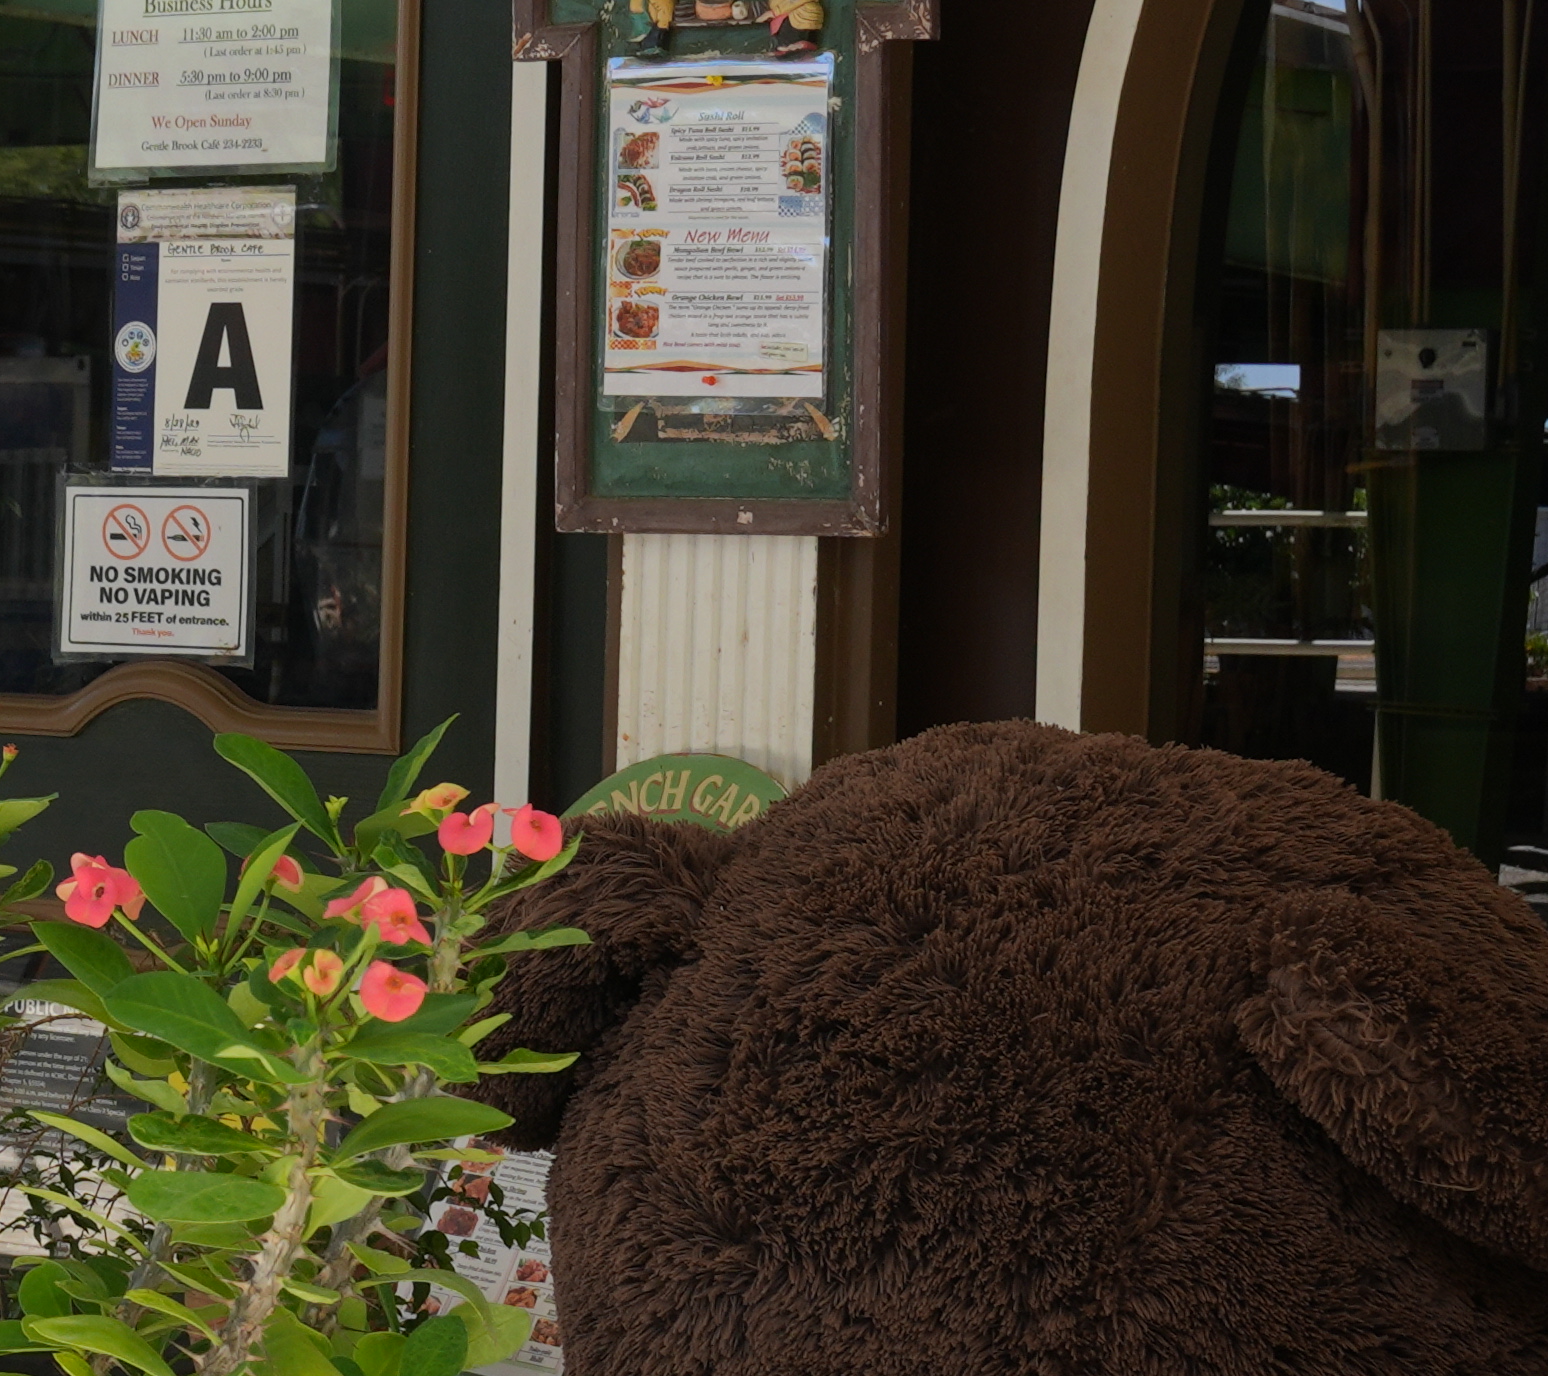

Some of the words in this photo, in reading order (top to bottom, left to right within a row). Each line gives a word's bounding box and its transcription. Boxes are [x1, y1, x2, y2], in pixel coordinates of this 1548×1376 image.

[112, 29, 159, 45] LUNCH
[183, 26, 212, 42] 11:30
[215, 30, 233, 40] am
[236, 27, 247, 40] to
[251, 24, 276, 39] 2:00
[280, 27, 299, 41] pm
[230, 45, 253, 57] order
[255, 46, 263, 56] at
[286, 46, 301, 58] pm
[109, 72, 159, 88] DINNER
[180, 69, 204, 84] 5:30
[207, 71, 226, 85] pm
[229, 69, 241, 82] to
[244, 67, 269, 82] 9:00
[272, 69, 292, 84] pm
[228, 89, 251, 100] order
[253, 89, 261, 98] at
[263, 88, 283, 98] 8:30
[285, 89, 299, 100] pm
[151, 115, 172, 130] We
[174, 115, 207, 132] Open
[210, 113, 252, 131] Sunday
[698, 111, 723, 122] Sushi
[726, 110, 745, 121] Roll
[141, 140, 168, 152] Gentle
[172, 139, 199, 152] Brook
[201, 139, 221, 151] Café
[684, 229, 722, 244] New
[726, 228, 770, 244] Menu
[184, 302, 264, 410] A
[90, 565, 119, 583] NO
[124, 566, 222, 586] SMOKING
[99, 587, 129, 604] NO
[133, 588, 211, 607] VAPING
[80, 611, 112, 623] within
[115, 612, 129, 623] 25
[131, 611, 164, 623] FEET
[166, 614, 177, 624] of
[178, 616, 230, 626] entrance.
[131, 627, 156, 636] Thank
[4, 998, 59, 1017] PUBLIC
